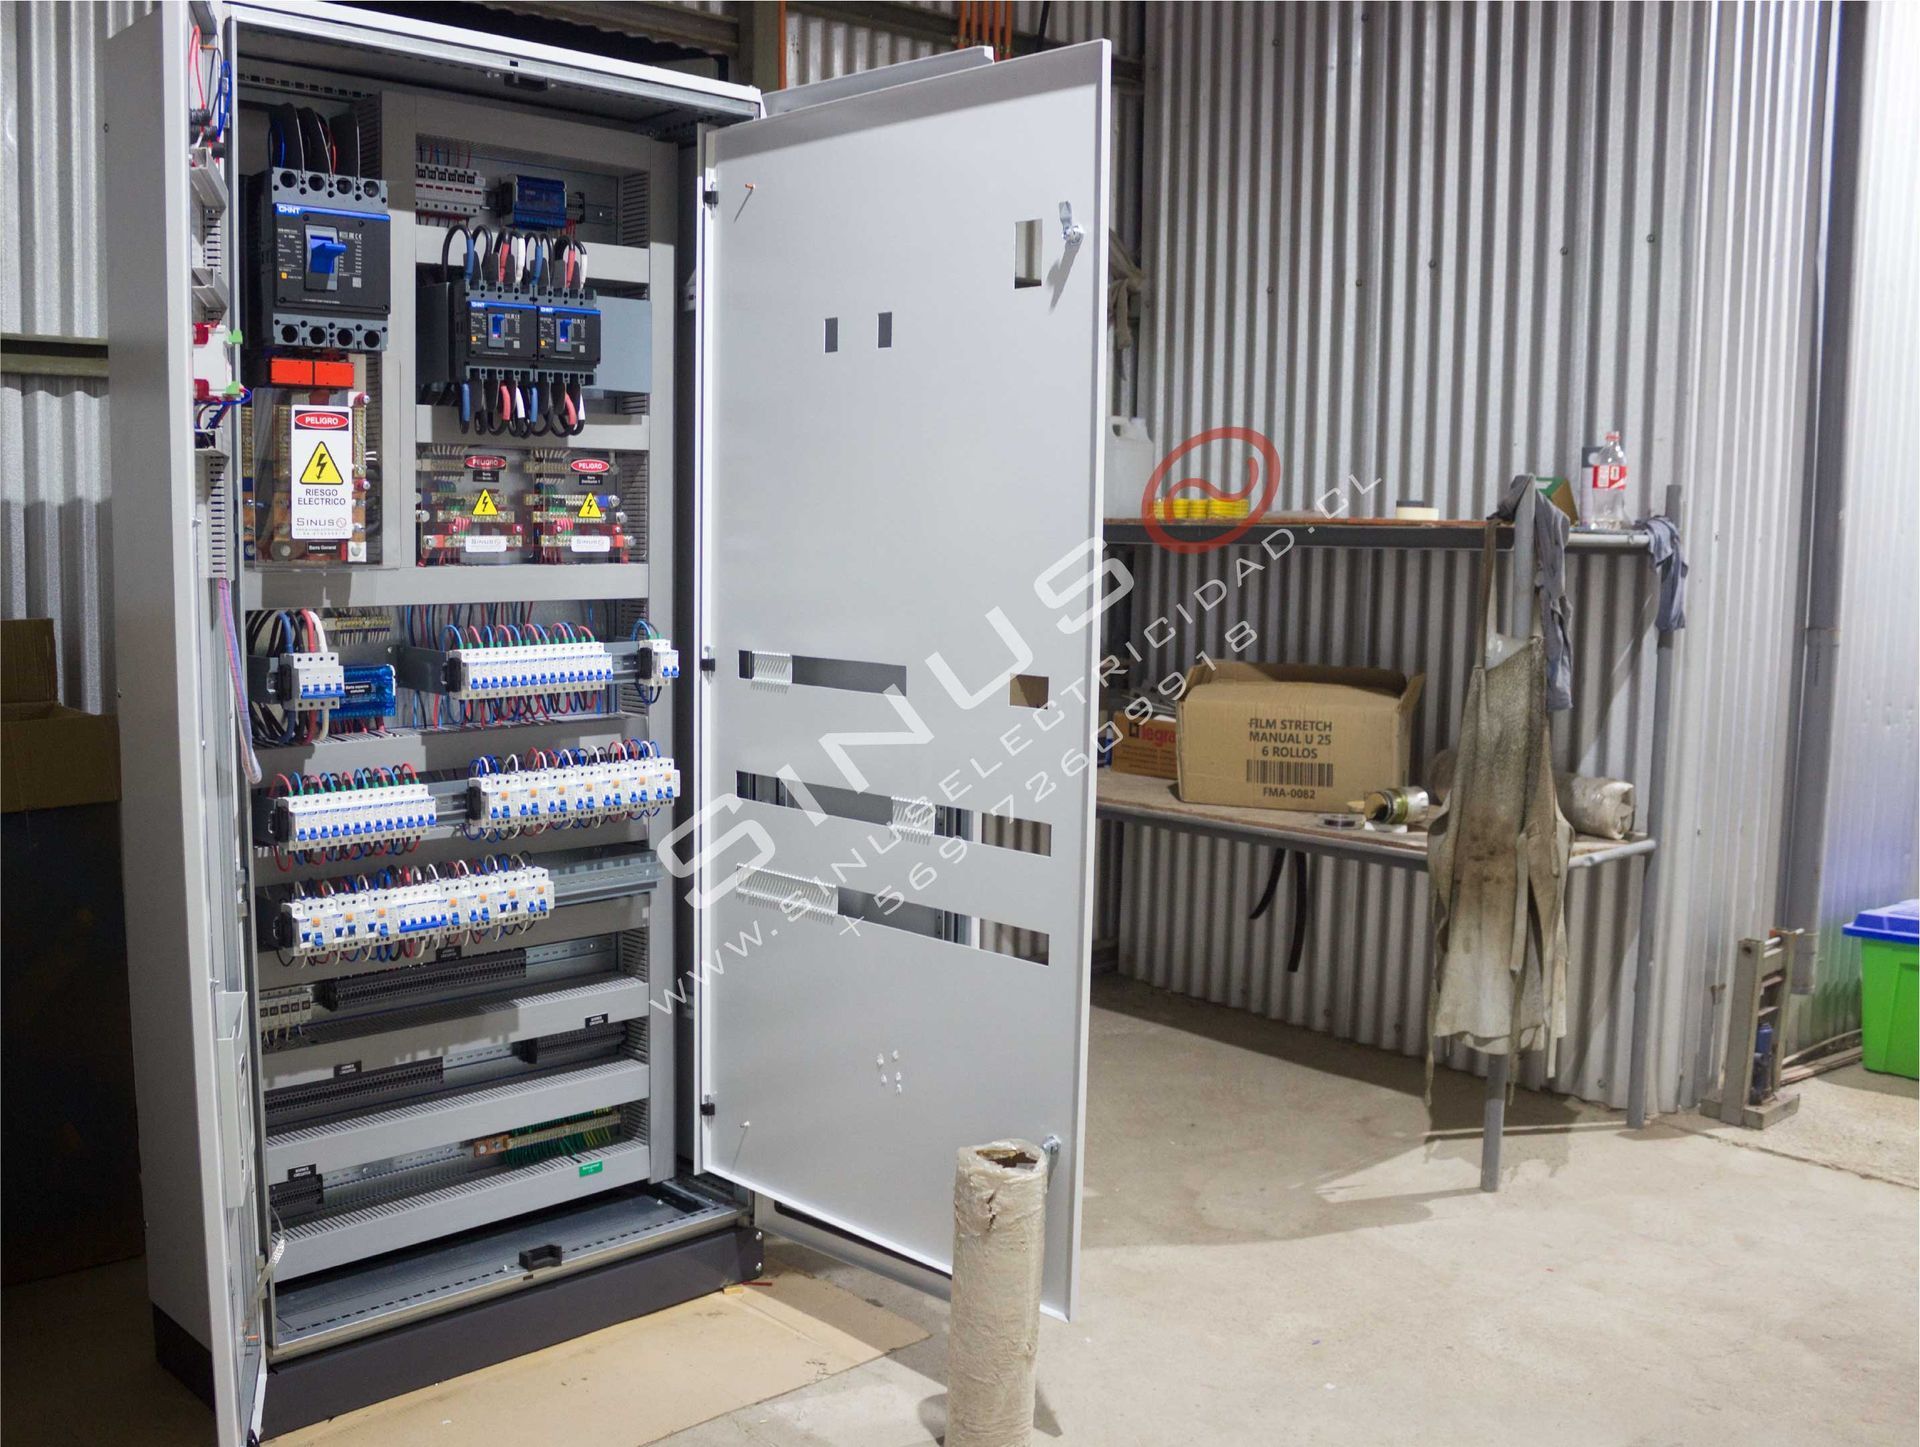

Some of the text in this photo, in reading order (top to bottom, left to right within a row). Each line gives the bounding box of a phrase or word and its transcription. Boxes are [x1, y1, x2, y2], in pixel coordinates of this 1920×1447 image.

[305, 416, 338, 425] PELIGRO
[305, 488, 338, 497] RIESGO
[297, 497, 346, 506] ELECTRICO
[296, 517, 335, 527] SINUS
[1248, 718, 1332, 732] FILM STRETCH
[1249, 731, 1332, 746] MANUAL U 25
[1261, 745, 1318, 759] 6 ROLLOS
[1263, 787, 1316, 800] FMA-0082
